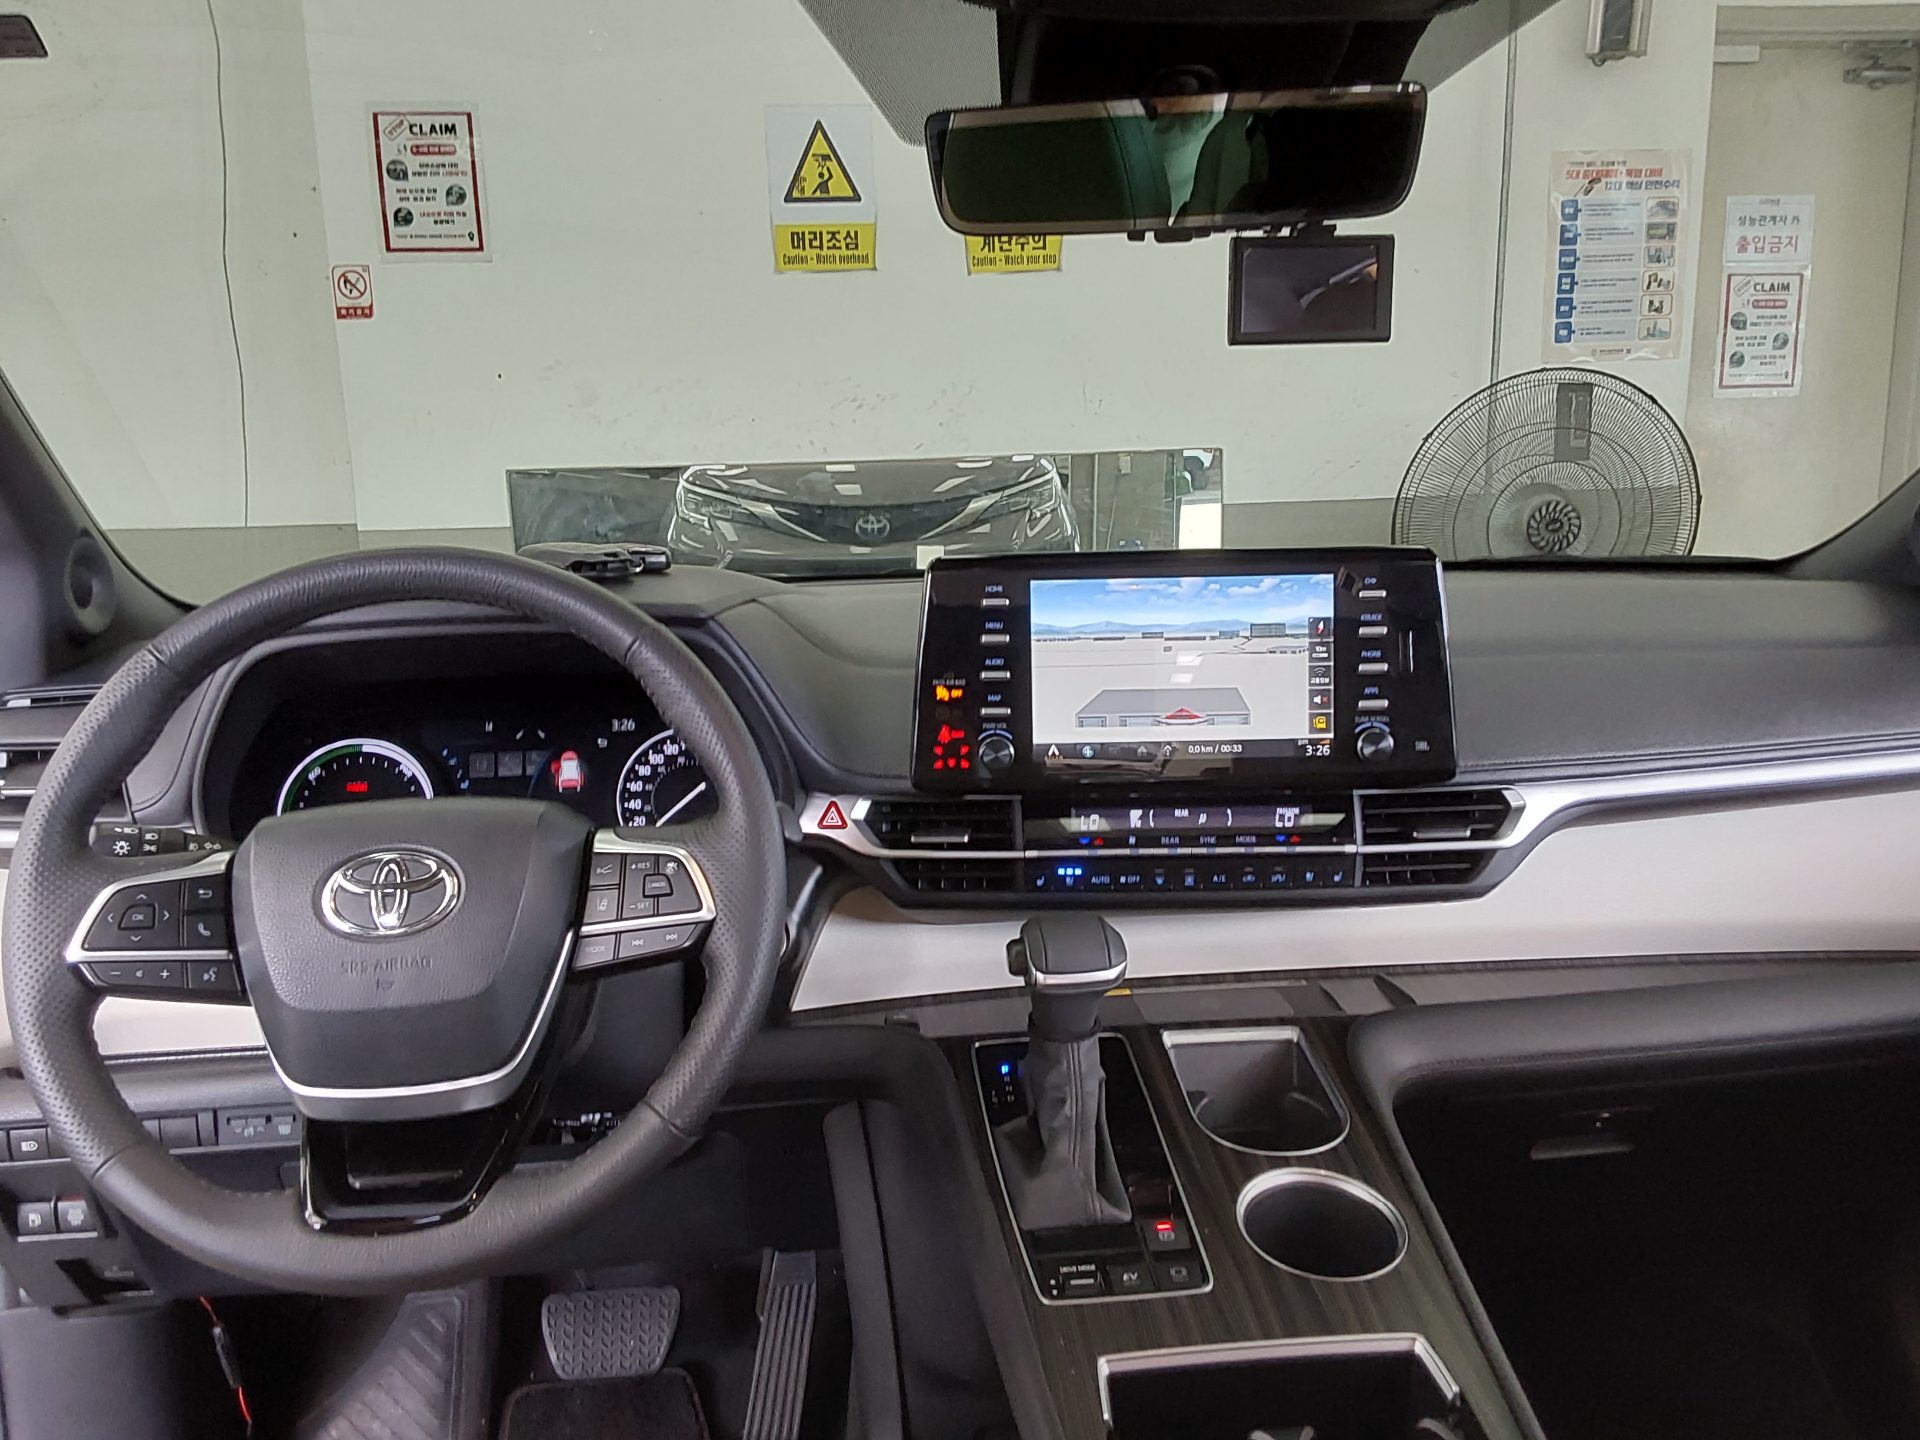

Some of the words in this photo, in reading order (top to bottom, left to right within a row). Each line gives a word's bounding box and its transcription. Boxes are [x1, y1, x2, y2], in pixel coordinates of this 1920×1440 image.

[409, 123, 457, 136] CLAIM
[790, 230, 860, 251] 머리조심
[980, 235, 1047, 252] 계단주의
[1736, 235, 1799, 254] 출입금지
[783, 253, 809, 265] Caution
[816, 253, 837, 265] Watch
[839, 252, 870, 264] overhead
[972, 255, 997, 267] Caution
[1004, 253, 1024, 265] Watch
[1026, 253, 1040, 265] your
[1042, 253, 1057, 264] step
[1753, 282, 1791, 293] CLAIM
[1188, 745, 1200, 753] 0.0
[1201, 744, 1213, 753] km
[1221, 744, 1242, 752] 00:33
[1305, 745, 1330, 756] 3:26
[638, 765, 651, 776] 80
[630, 781, 643, 792] 60
[628, 799, 642, 810] 40
[633, 816, 646, 827] 20
[1091, 875, 1110, 884] AUTO
[1123, 1271, 1138, 1281] EV
